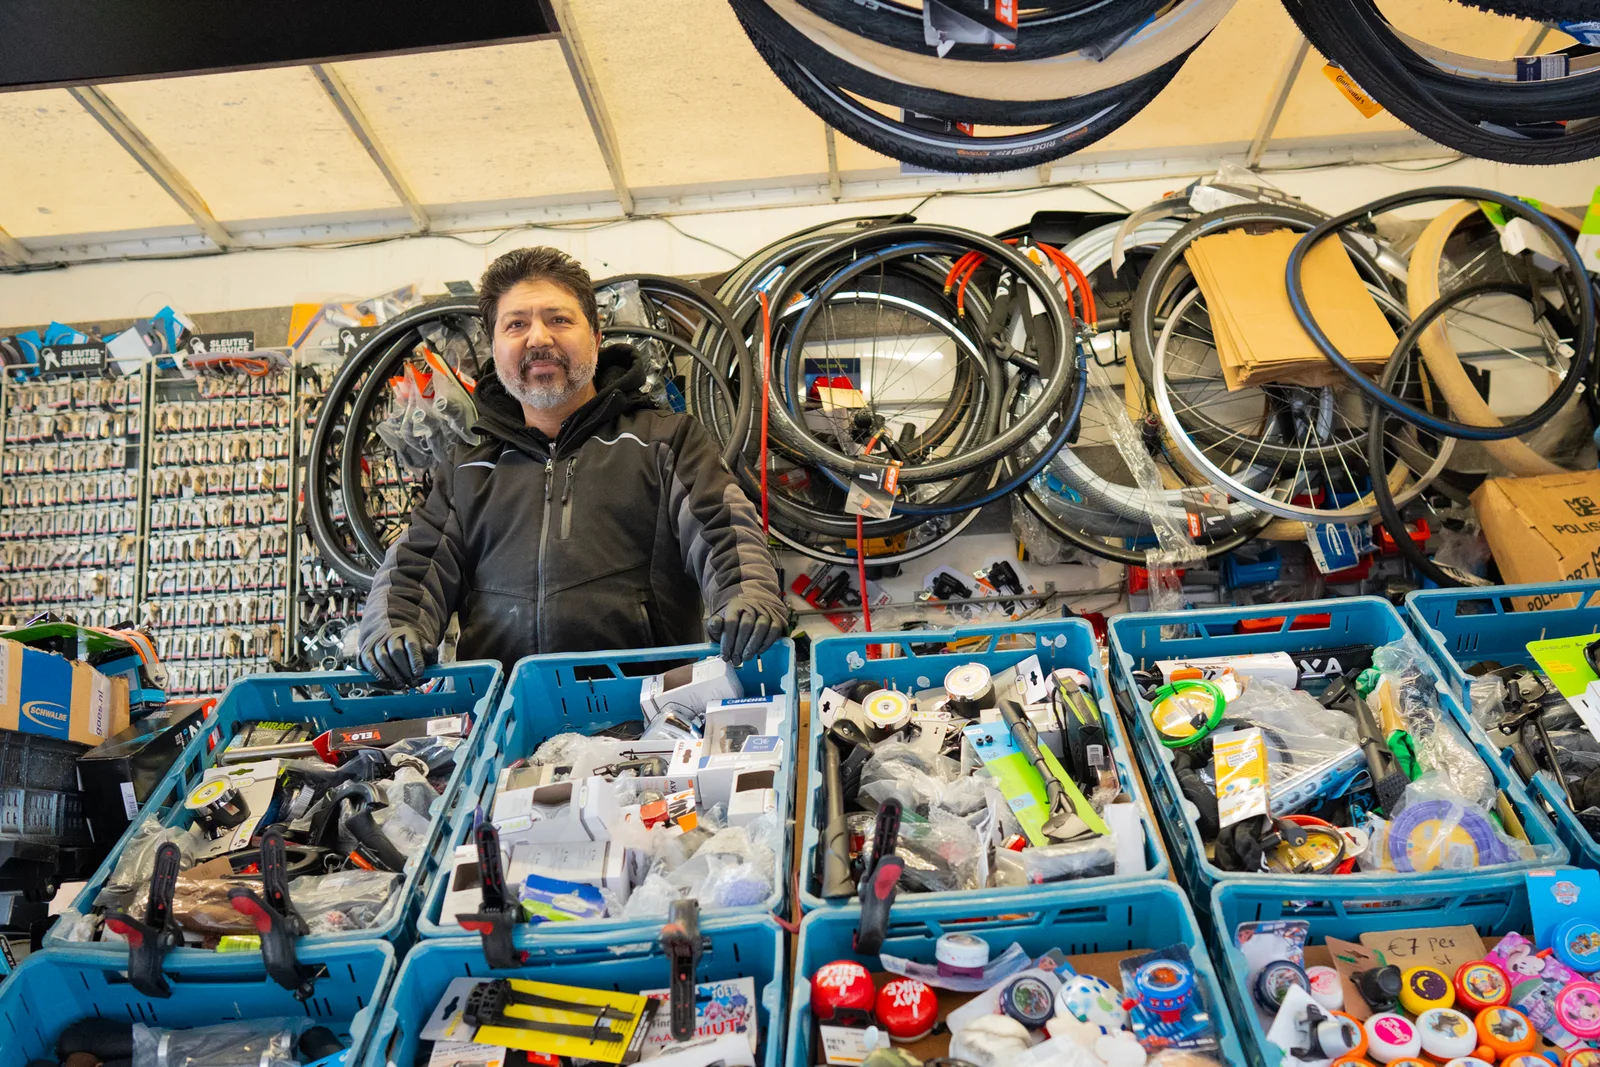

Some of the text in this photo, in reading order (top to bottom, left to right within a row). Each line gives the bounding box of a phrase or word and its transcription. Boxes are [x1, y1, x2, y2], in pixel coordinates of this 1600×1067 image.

[1336, 75, 1362, 102] Continental
[210, 338, 253, 347] SLEUTEL-
[61, 349, 105, 359] SLEUTEL-
[61, 357, 100, 367] SERVICE
[859, 472, 878, 482] 1
[885, 467, 897, 492] CST
[1188, 515, 1199, 536] CST
[30, 706, 68, 722] SCHWALBE
[95, 690, 104, 736] goes.nl
[256, 721, 297, 730] MIRAG
[342, 731, 381, 742] VELOX
[823, 974, 855, 987] MY
[893, 992, 921, 1008] MY
